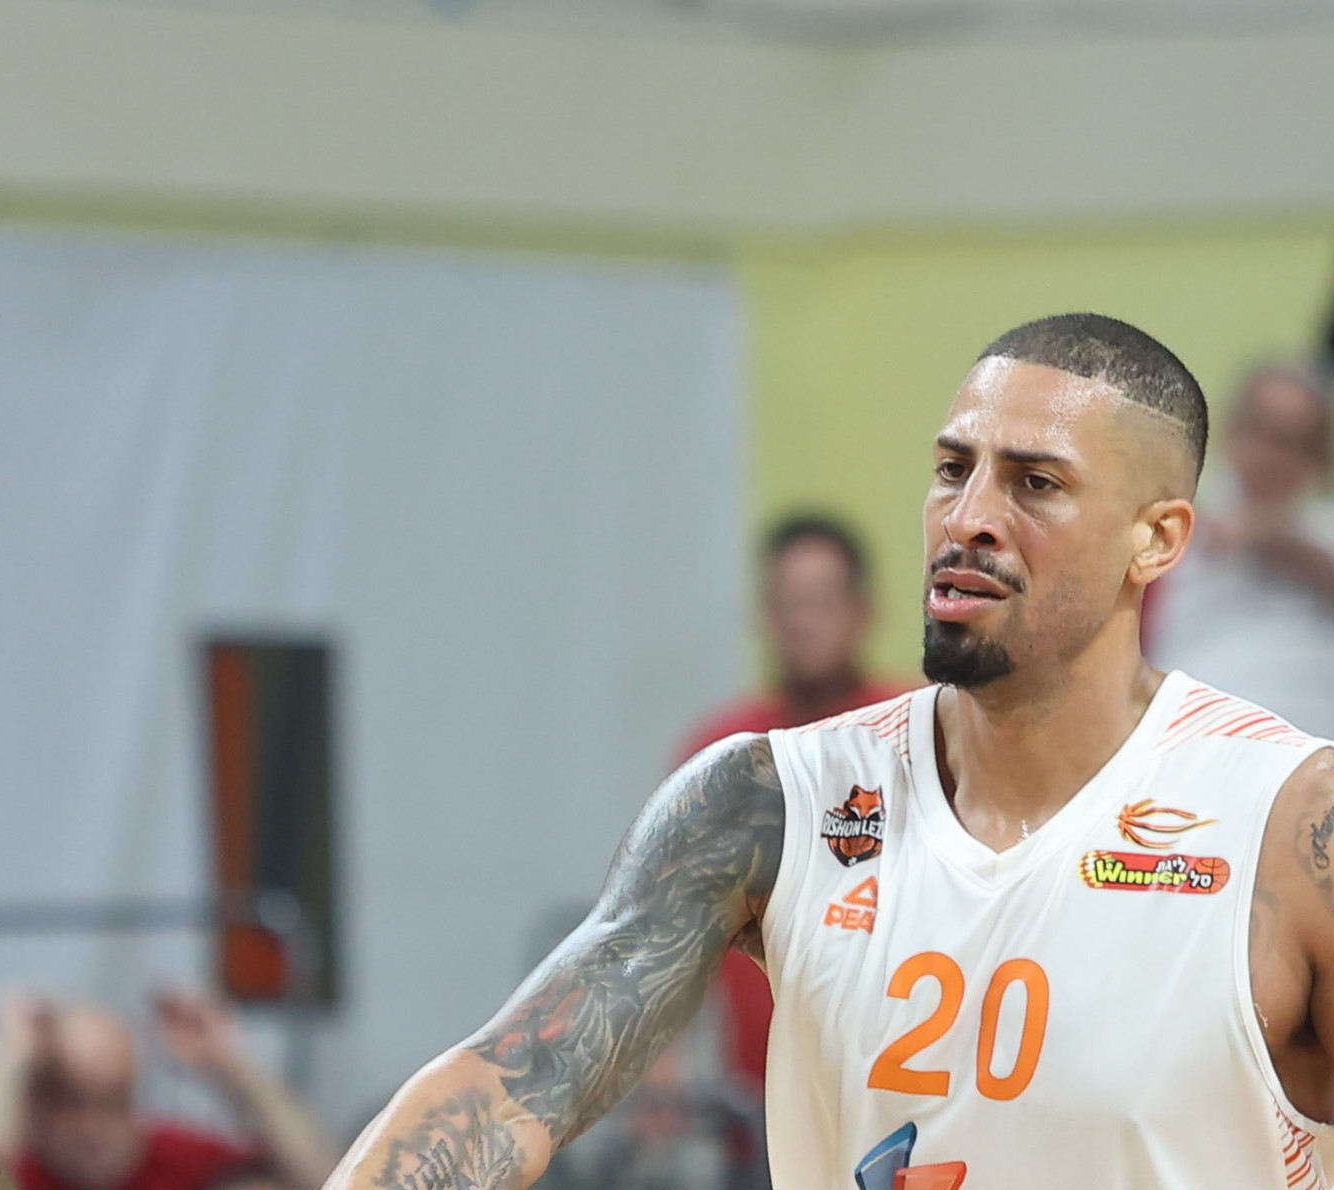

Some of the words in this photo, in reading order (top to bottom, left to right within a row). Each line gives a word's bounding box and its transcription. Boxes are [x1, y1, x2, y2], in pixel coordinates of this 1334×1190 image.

[1189, 869, 1213, 889] סל
[824, 903, 877, 935] PEA
[867, 951, 1050, 1102] 20
